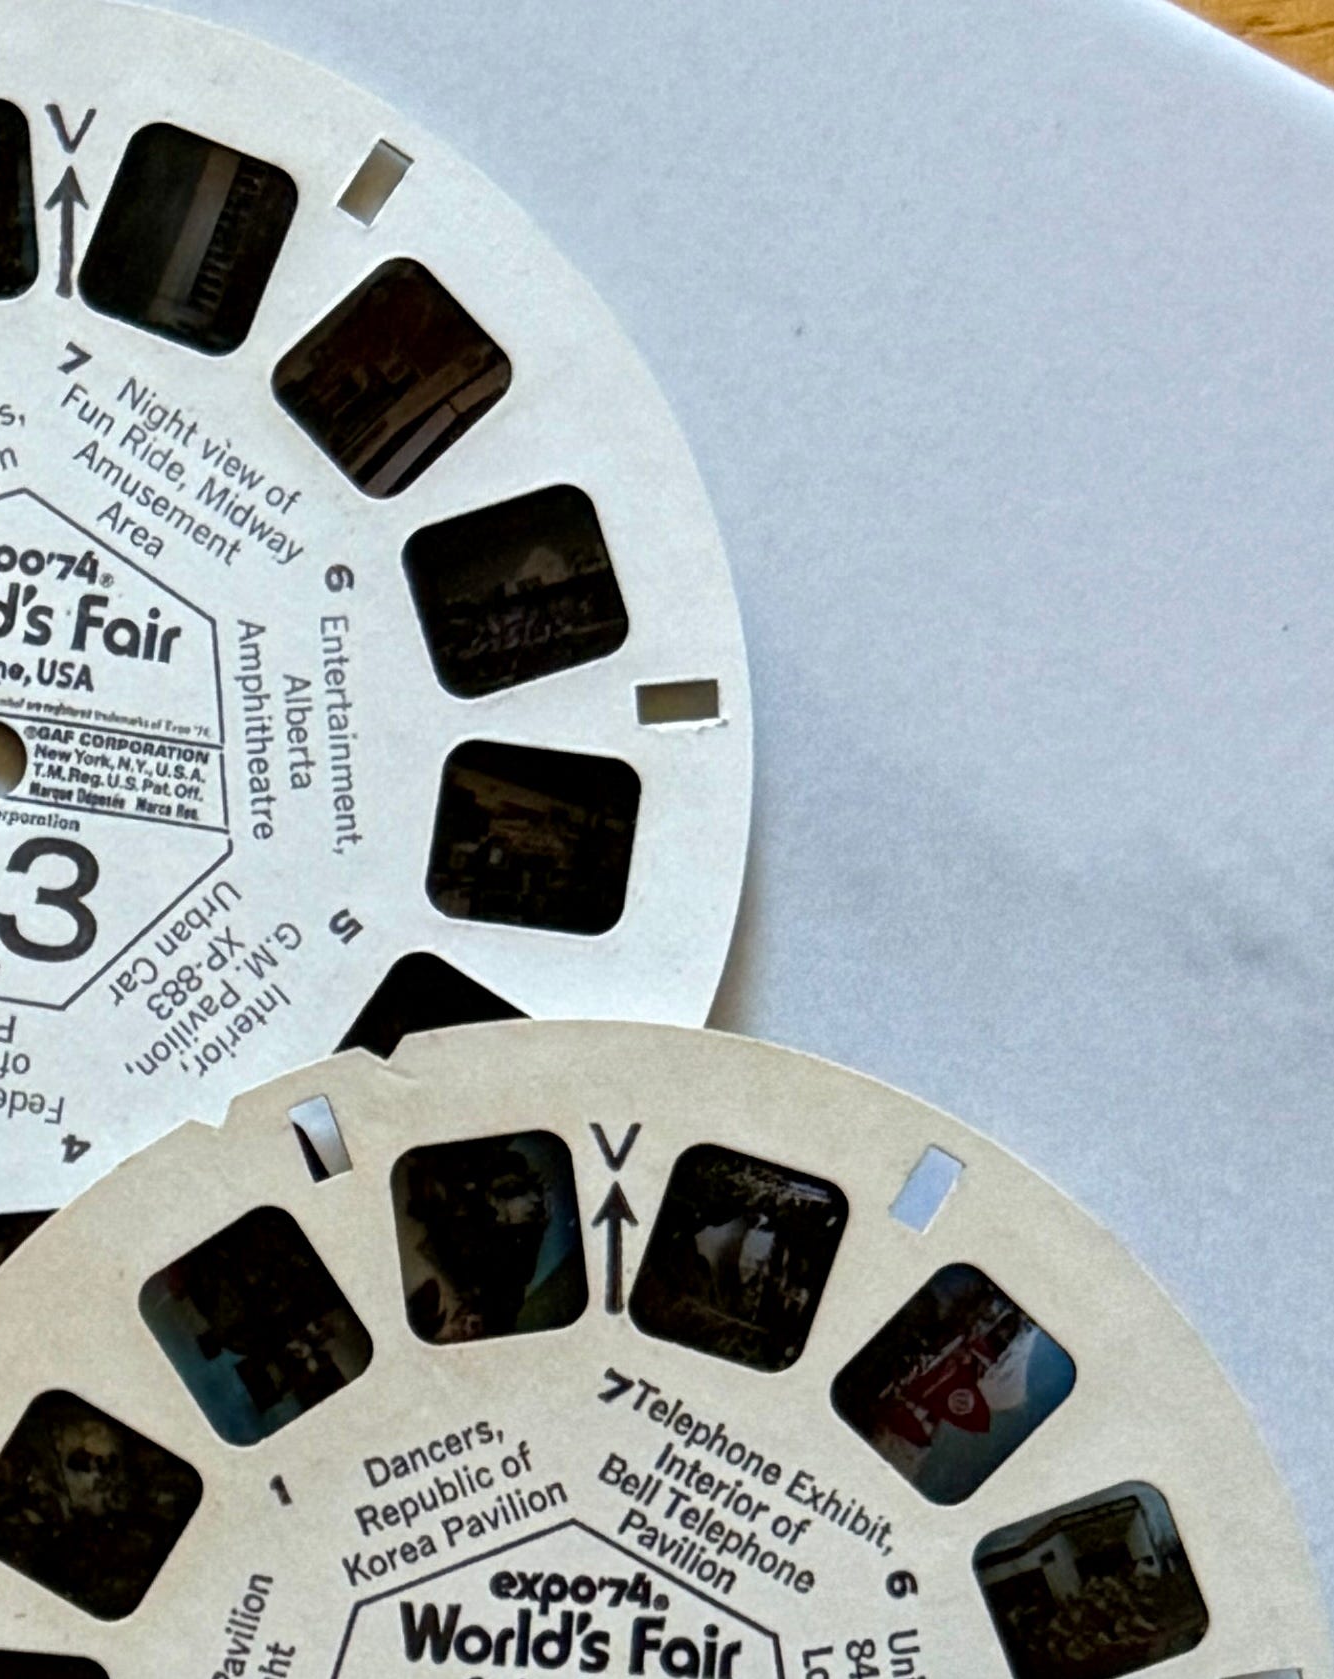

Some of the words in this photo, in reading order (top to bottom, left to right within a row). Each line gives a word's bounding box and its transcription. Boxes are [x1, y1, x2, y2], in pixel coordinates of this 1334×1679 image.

[47, 105, 95, 152] V
[71, 594, 181, 663] Fair
[37, 658, 93, 691] USA
[78, 732, 210, 765] CORPORATION
[154, 881, 242, 956] Urban
[235, 922, 301, 980] G.M.
[108, 957, 158, 1006] Car
[146, 925, 245, 1020] XP-883
[124, 978, 241, 1075] Pavilion,
[180, 983, 290, 1077] Interior,
[354, 1464, 494, 1536] Republic
[500, 1439, 531, 1478] of
[362, 1420, 503, 1488] Dancers,
[341, 1534, 437, 1586] Korea
[440, 1481, 568, 1547] Pavilion
[400, 1601, 610, 1673] World's
